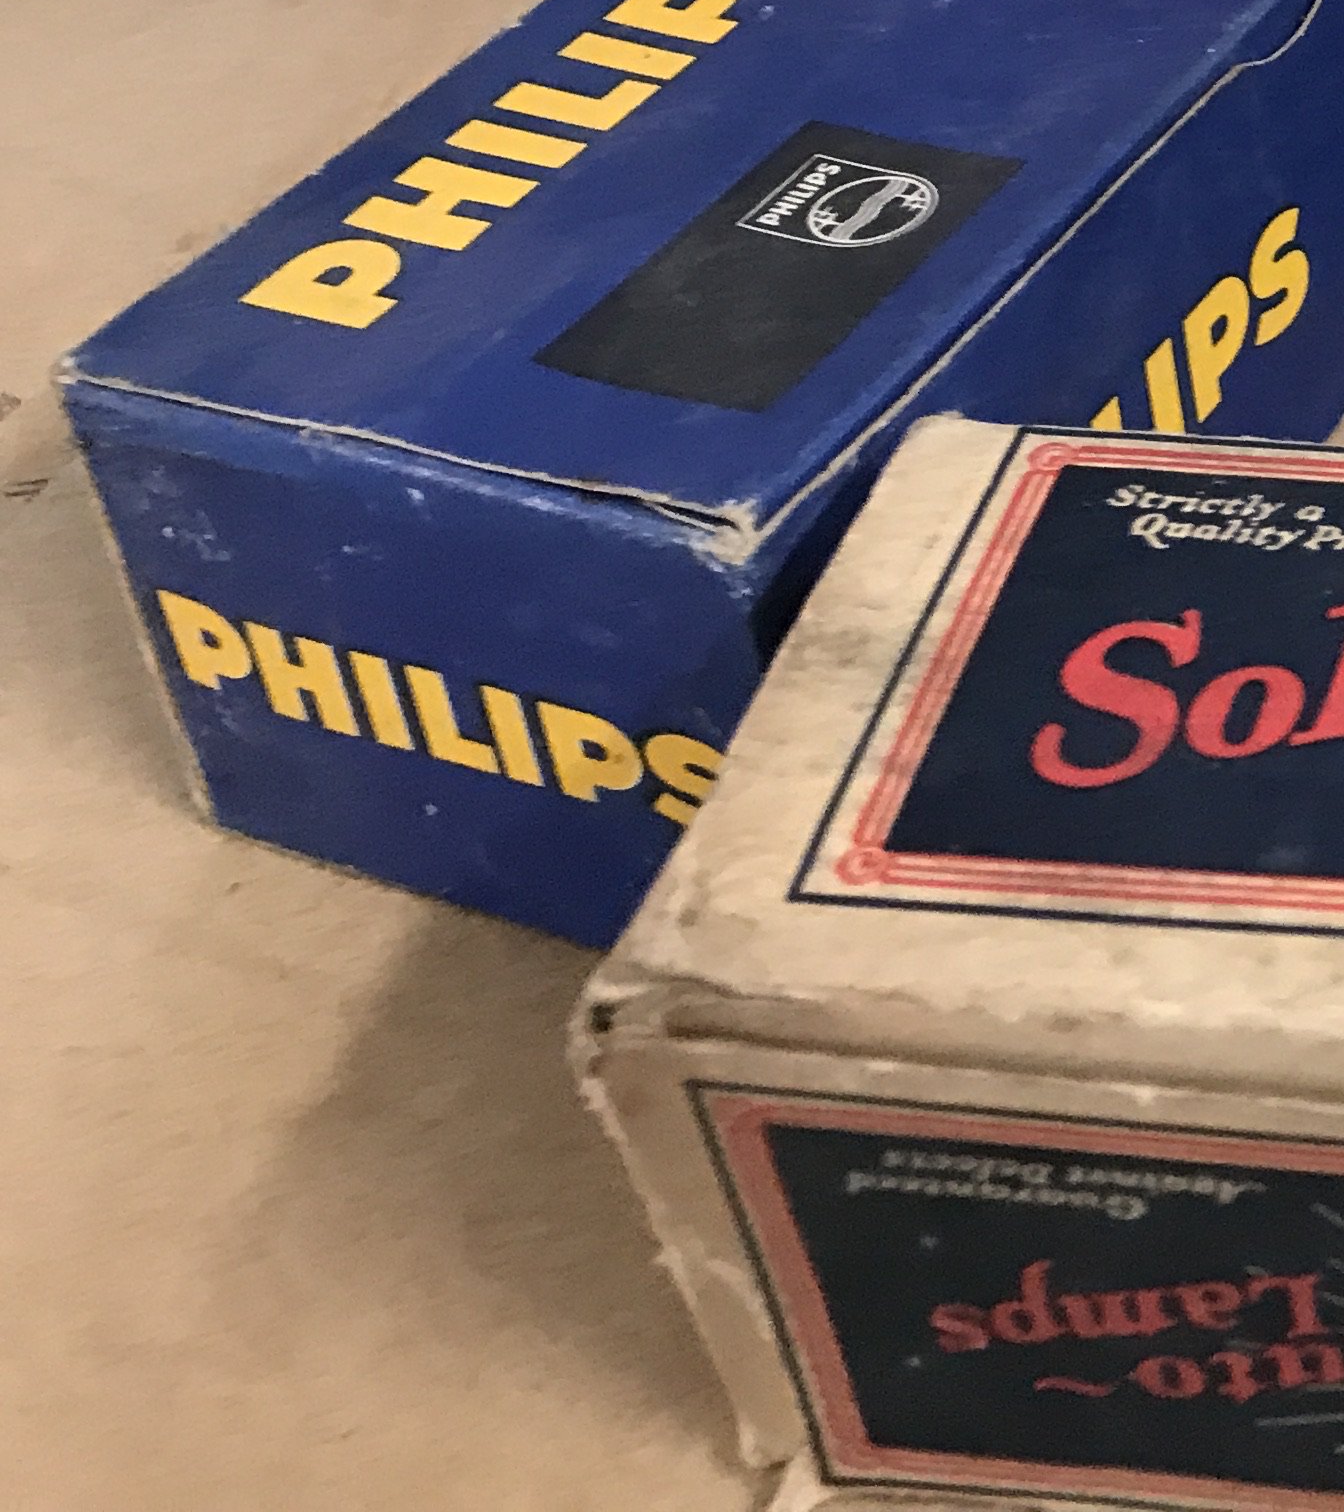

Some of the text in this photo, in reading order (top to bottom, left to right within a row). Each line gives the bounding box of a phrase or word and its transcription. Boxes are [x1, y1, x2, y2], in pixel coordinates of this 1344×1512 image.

[755, 161, 841, 227] PHILIPS
[1106, 485, 1326, 522] Strictly a
[1130, 513, 1305, 551] Quality
[156, 589, 725, 826] PHILIPS
[930, 1260, 1324, 1354] Lamps
